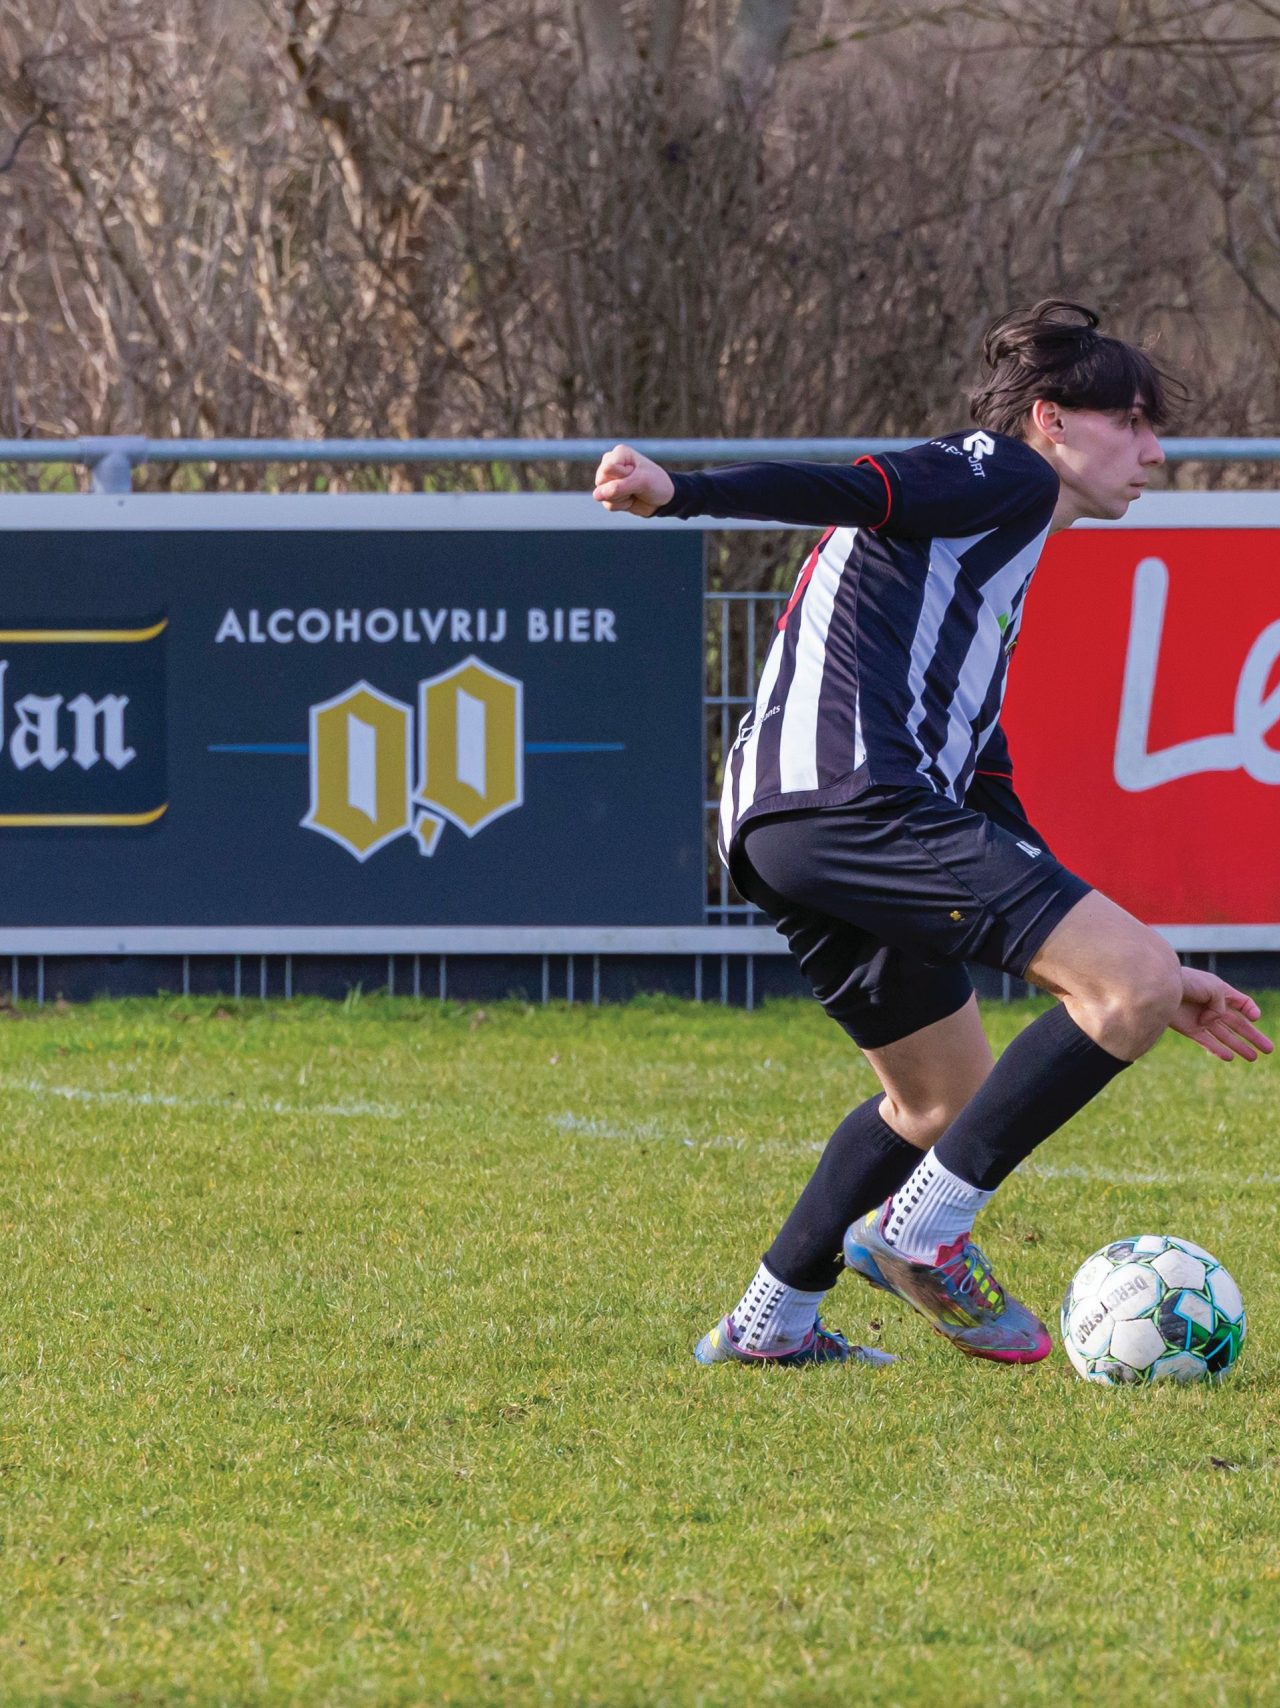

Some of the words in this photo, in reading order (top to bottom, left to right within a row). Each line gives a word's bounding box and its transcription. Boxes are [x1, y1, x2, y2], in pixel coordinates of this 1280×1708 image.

[215, 608, 507, 644] ALCOHOLVRIJ
[527, 608, 618, 643] BIER
[0, 659, 137, 771] an
